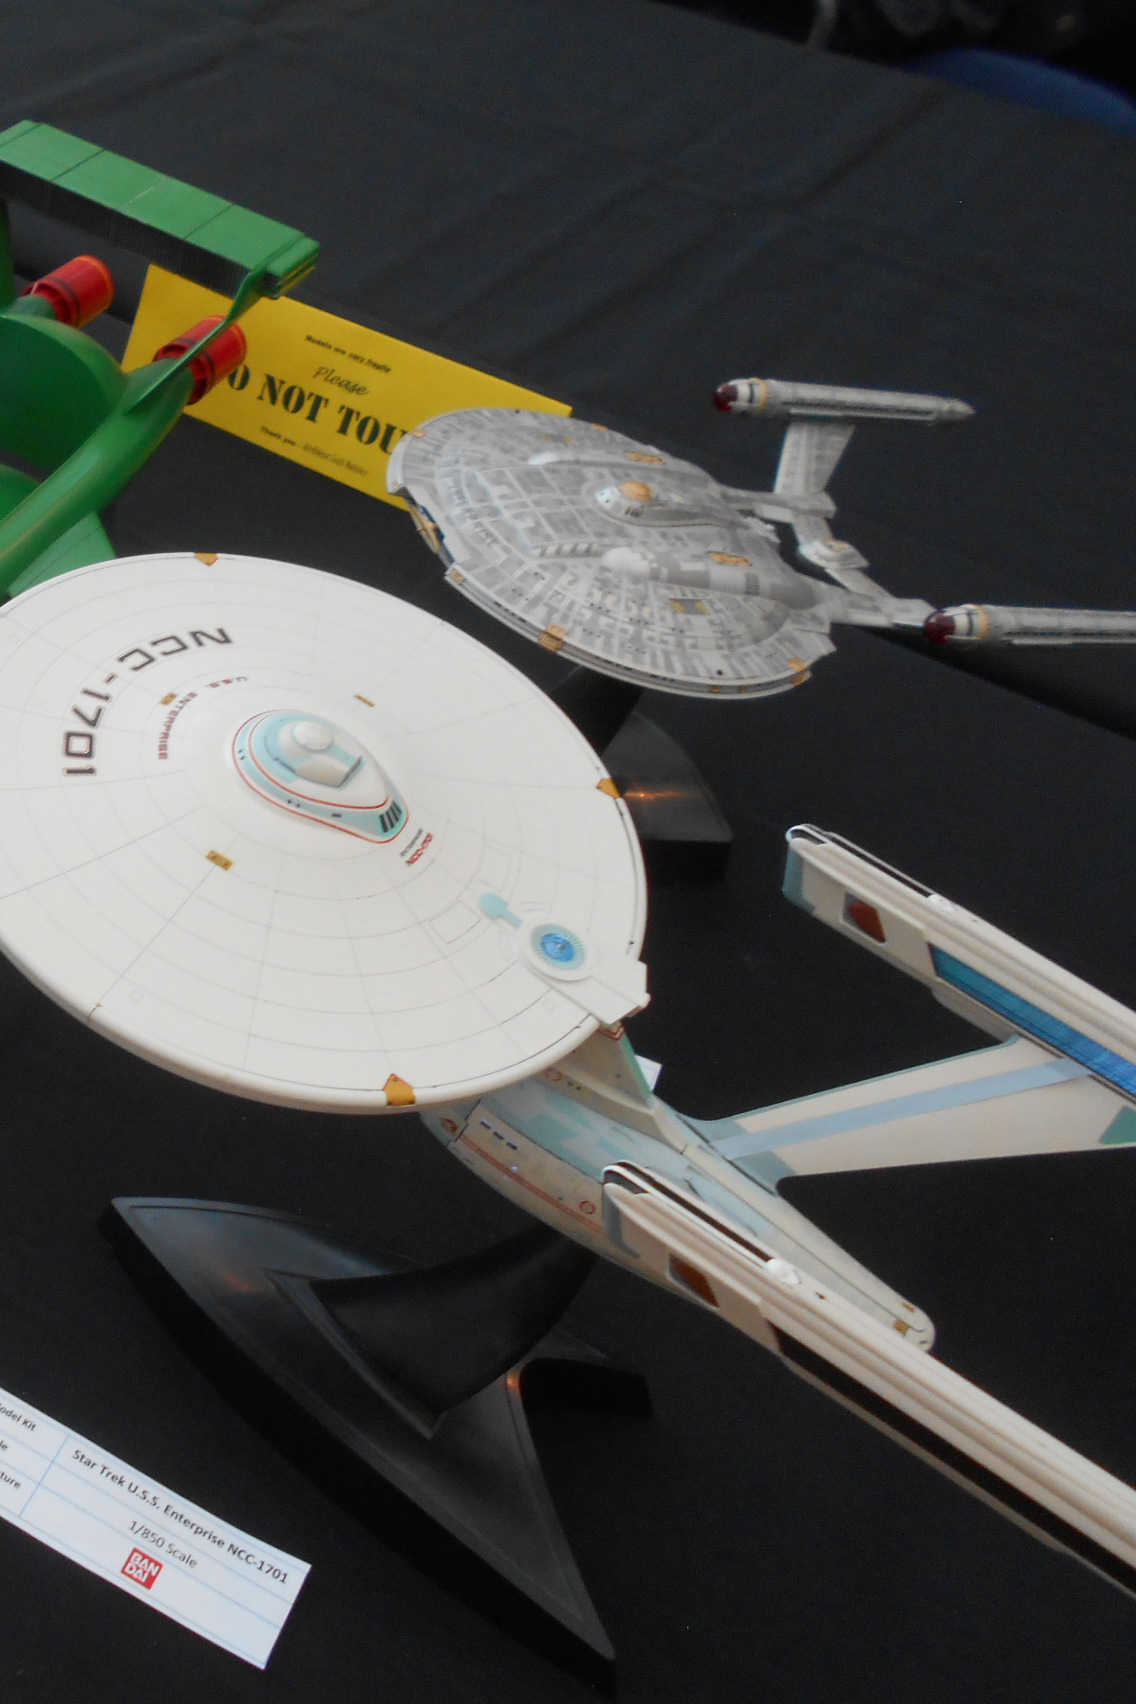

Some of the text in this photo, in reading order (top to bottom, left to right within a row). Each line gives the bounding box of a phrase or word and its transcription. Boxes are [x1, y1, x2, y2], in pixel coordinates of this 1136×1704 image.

[228, 364, 409, 454] O NOT TOU
[313, 366, 370, 395] Please
[64, 627, 233, 775] NCC-1701
[158, 692, 198, 760] ENTERPRISE
[22, 1419, 36, 1431] Kit
[72, 1450, 289, 1584] Star Trek U.S.S. Enterprise NCC-1701
[128, 1520, 198, 1568] 1/850 Scale
